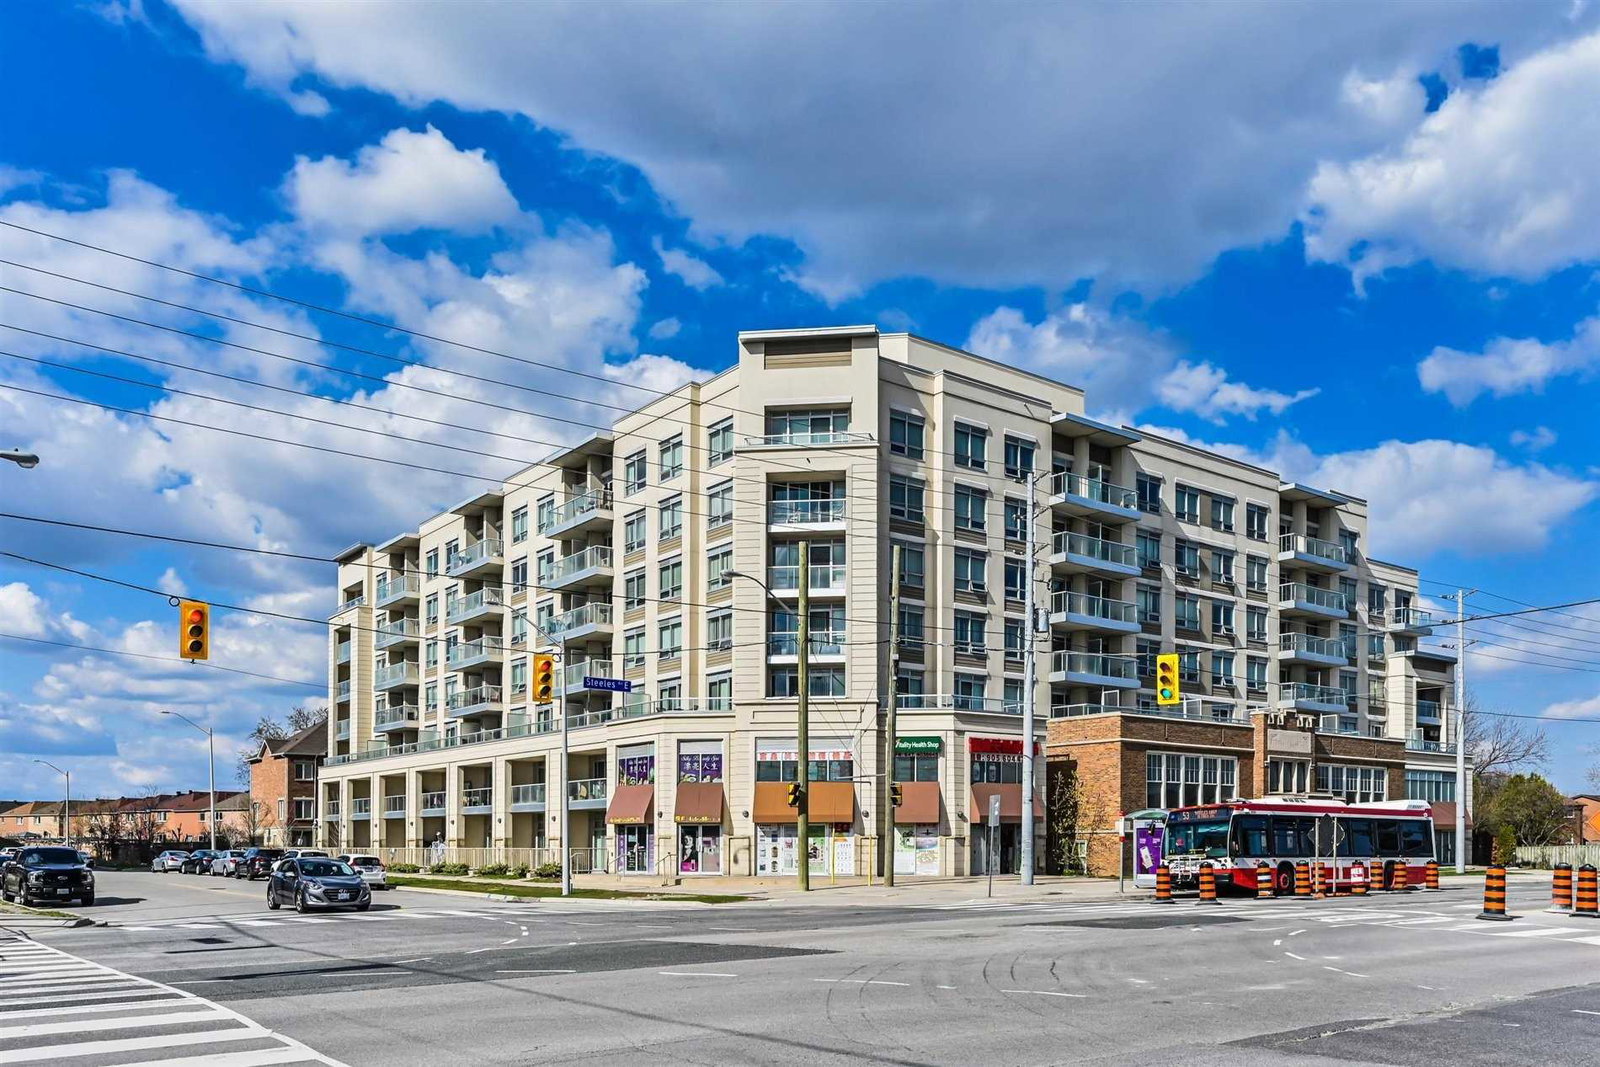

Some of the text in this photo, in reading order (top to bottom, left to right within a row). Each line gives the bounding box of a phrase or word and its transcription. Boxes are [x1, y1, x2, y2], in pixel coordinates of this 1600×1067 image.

[586, 677, 616, 689] Steeles
[624, 681, 629, 690] E
[895, 739, 911, 749] itality
[927, 741, 940, 750] Shop
[986, 754, 1000, 762] 905
[1182, 811, 1190, 821] 53
